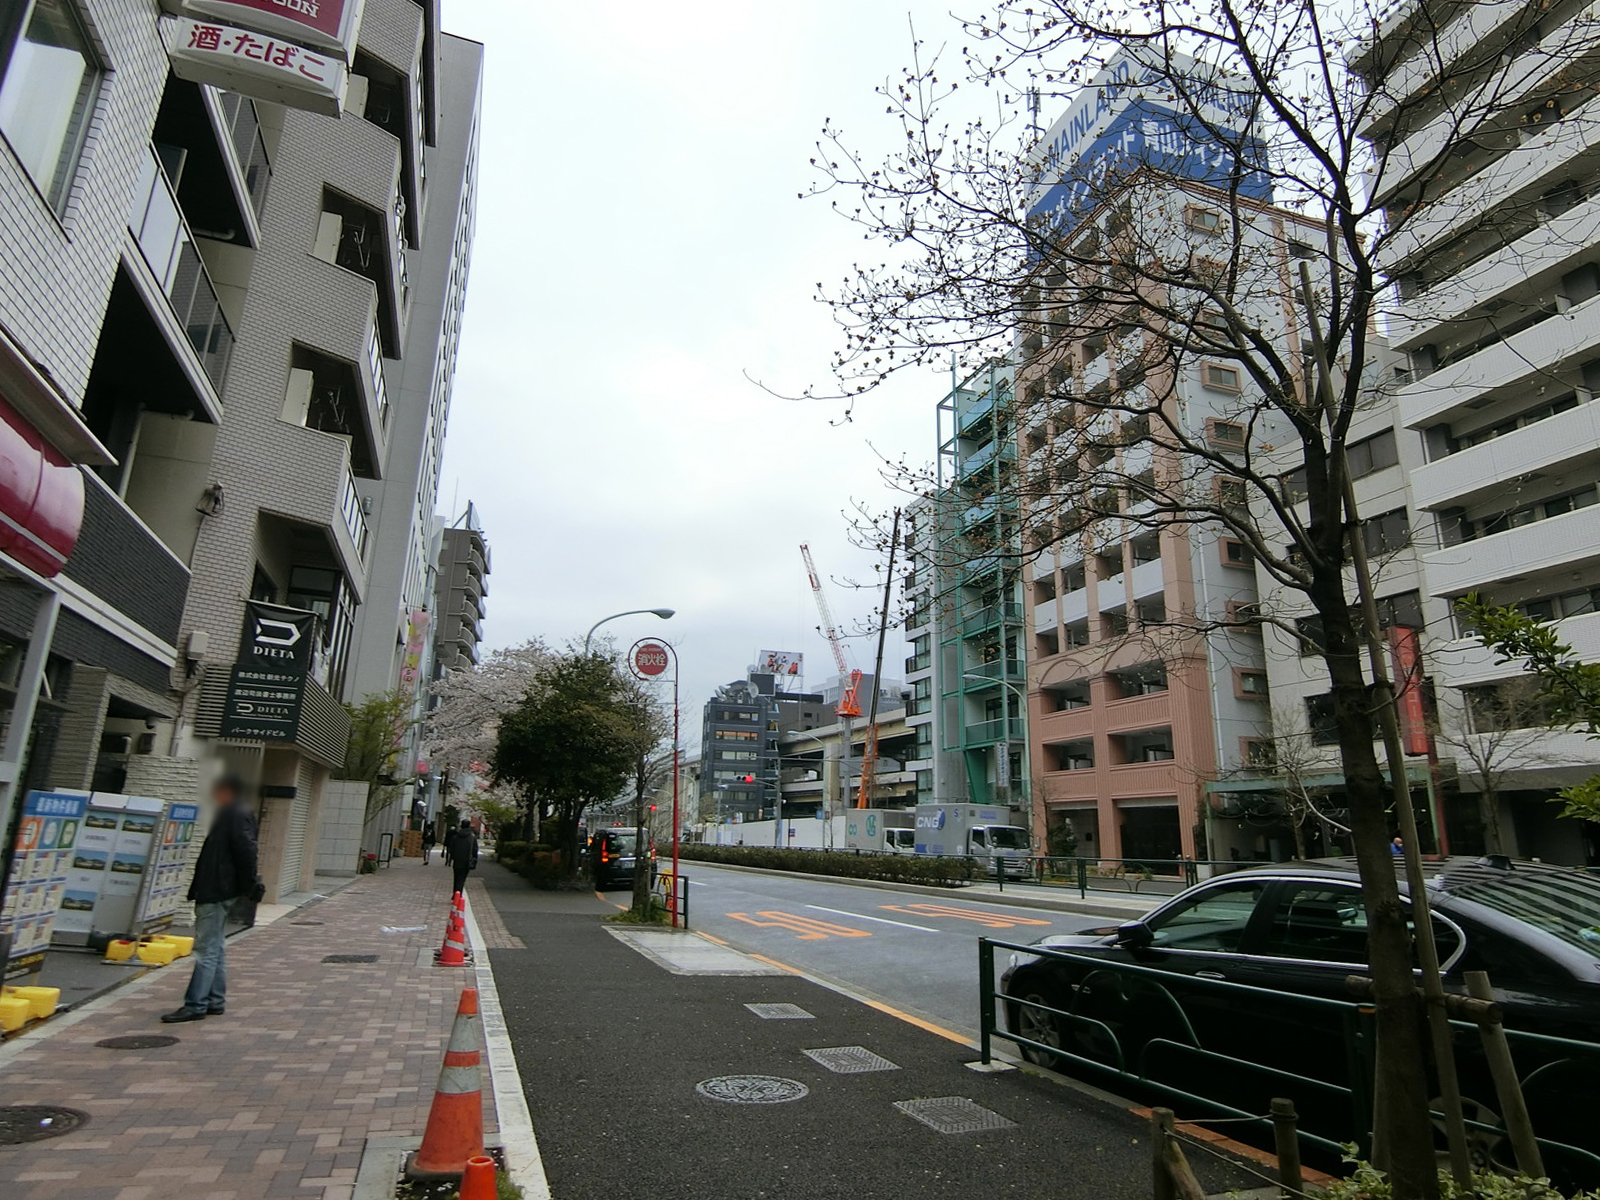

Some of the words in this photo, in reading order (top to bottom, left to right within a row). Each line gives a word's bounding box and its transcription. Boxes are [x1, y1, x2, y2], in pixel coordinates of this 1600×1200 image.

[187, 24, 325, 82] 酒・たばこ
[1047, 59, 1132, 171] MAINLAND
[253, 645, 295, 659] DIETA
[638, 653, 666, 666] 消火栓
[257, 706, 288, 715] DIETA
[231, 727, 287, 738] パークサイドビル
[916, 816, 939, 828] CNG
